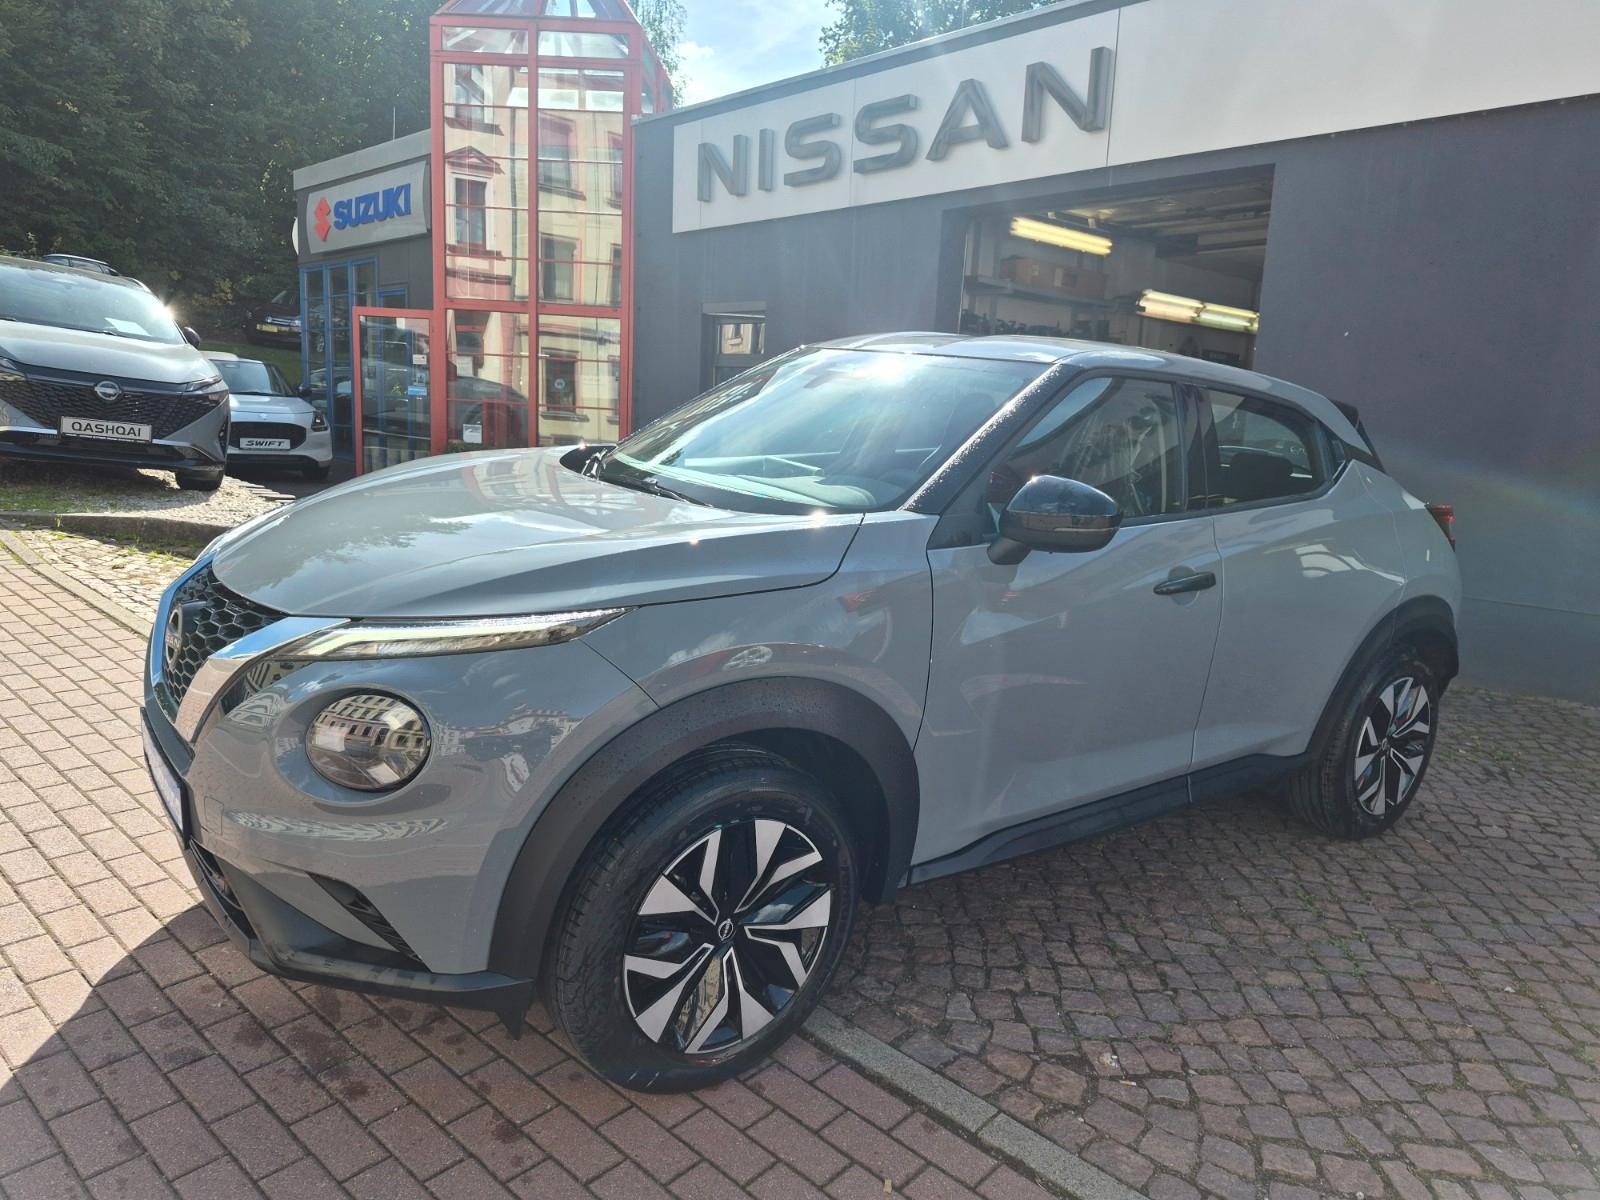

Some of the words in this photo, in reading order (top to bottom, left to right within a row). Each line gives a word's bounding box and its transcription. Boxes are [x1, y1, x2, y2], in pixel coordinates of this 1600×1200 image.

[697, 46, 1113, 202] NISSAN
[333, 183, 411, 230] SUZUKI
[71, 421, 142, 437] QASHQAI
[245, 439, 285, 448] SWIFT
